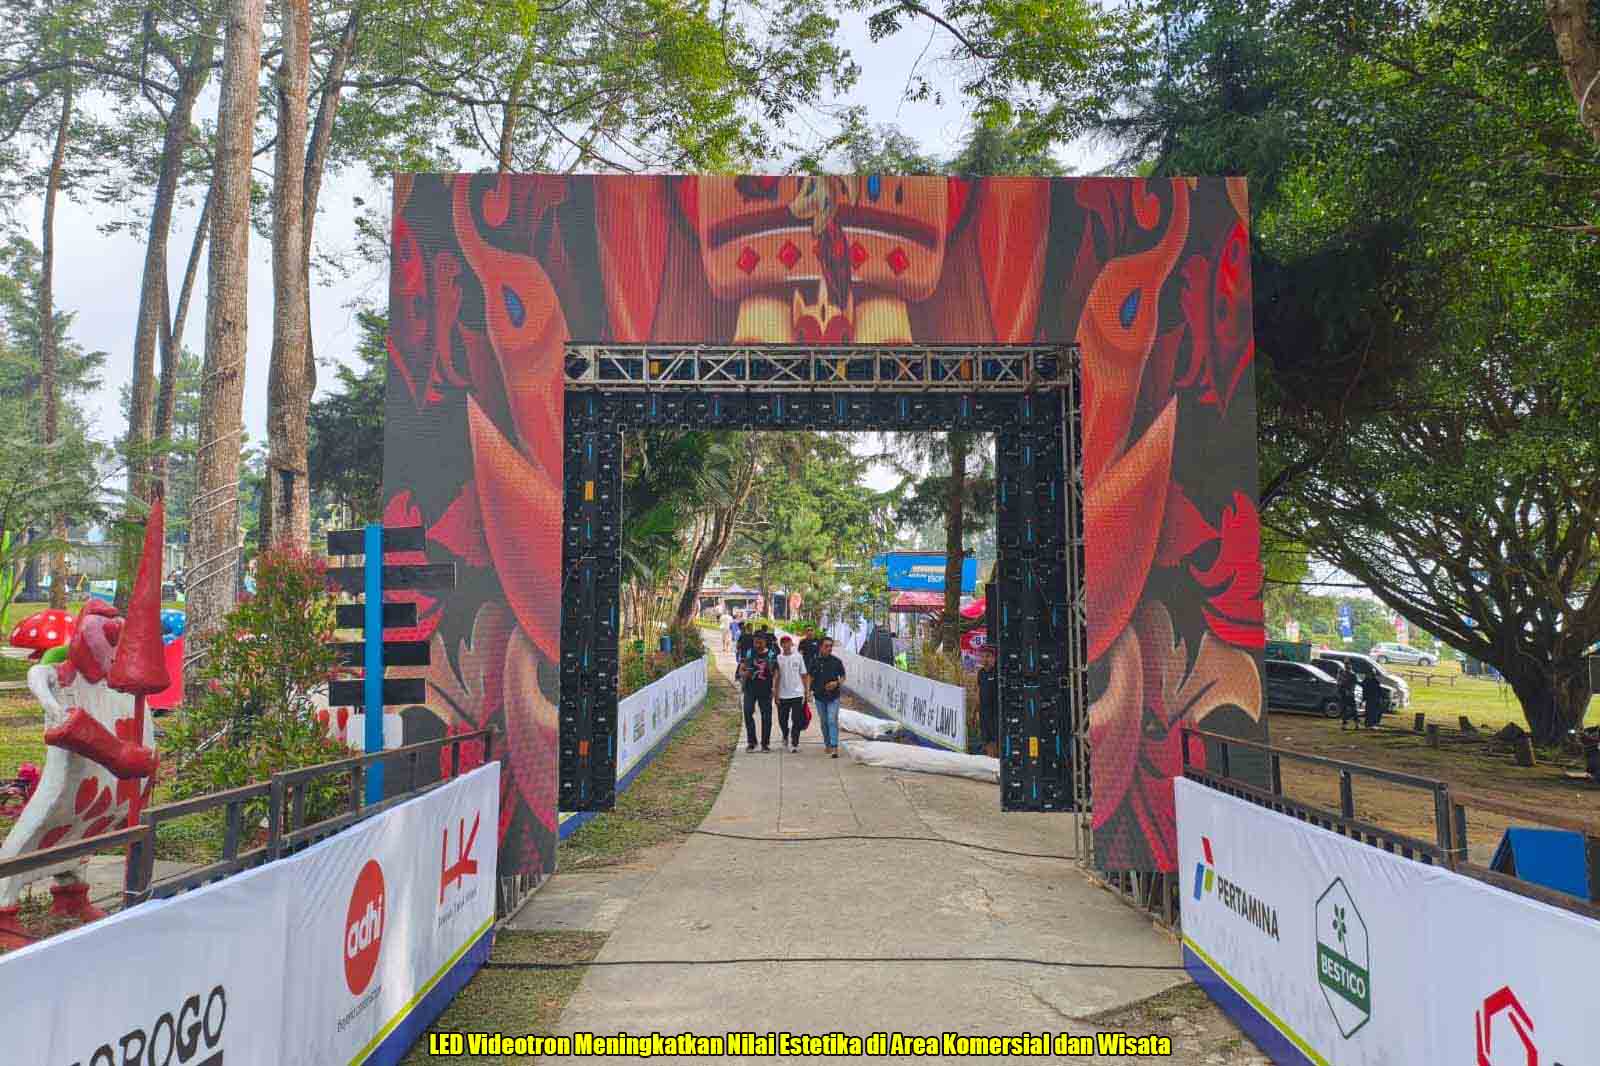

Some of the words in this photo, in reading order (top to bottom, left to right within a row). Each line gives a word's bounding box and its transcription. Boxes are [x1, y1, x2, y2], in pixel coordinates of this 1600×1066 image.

[935, 703, 958, 738] LAWU
[347, 893, 383, 959] adhi
[1217, 876, 1280, 942] PERTAMINA
[1320, 953, 1366, 999] BESTICO
